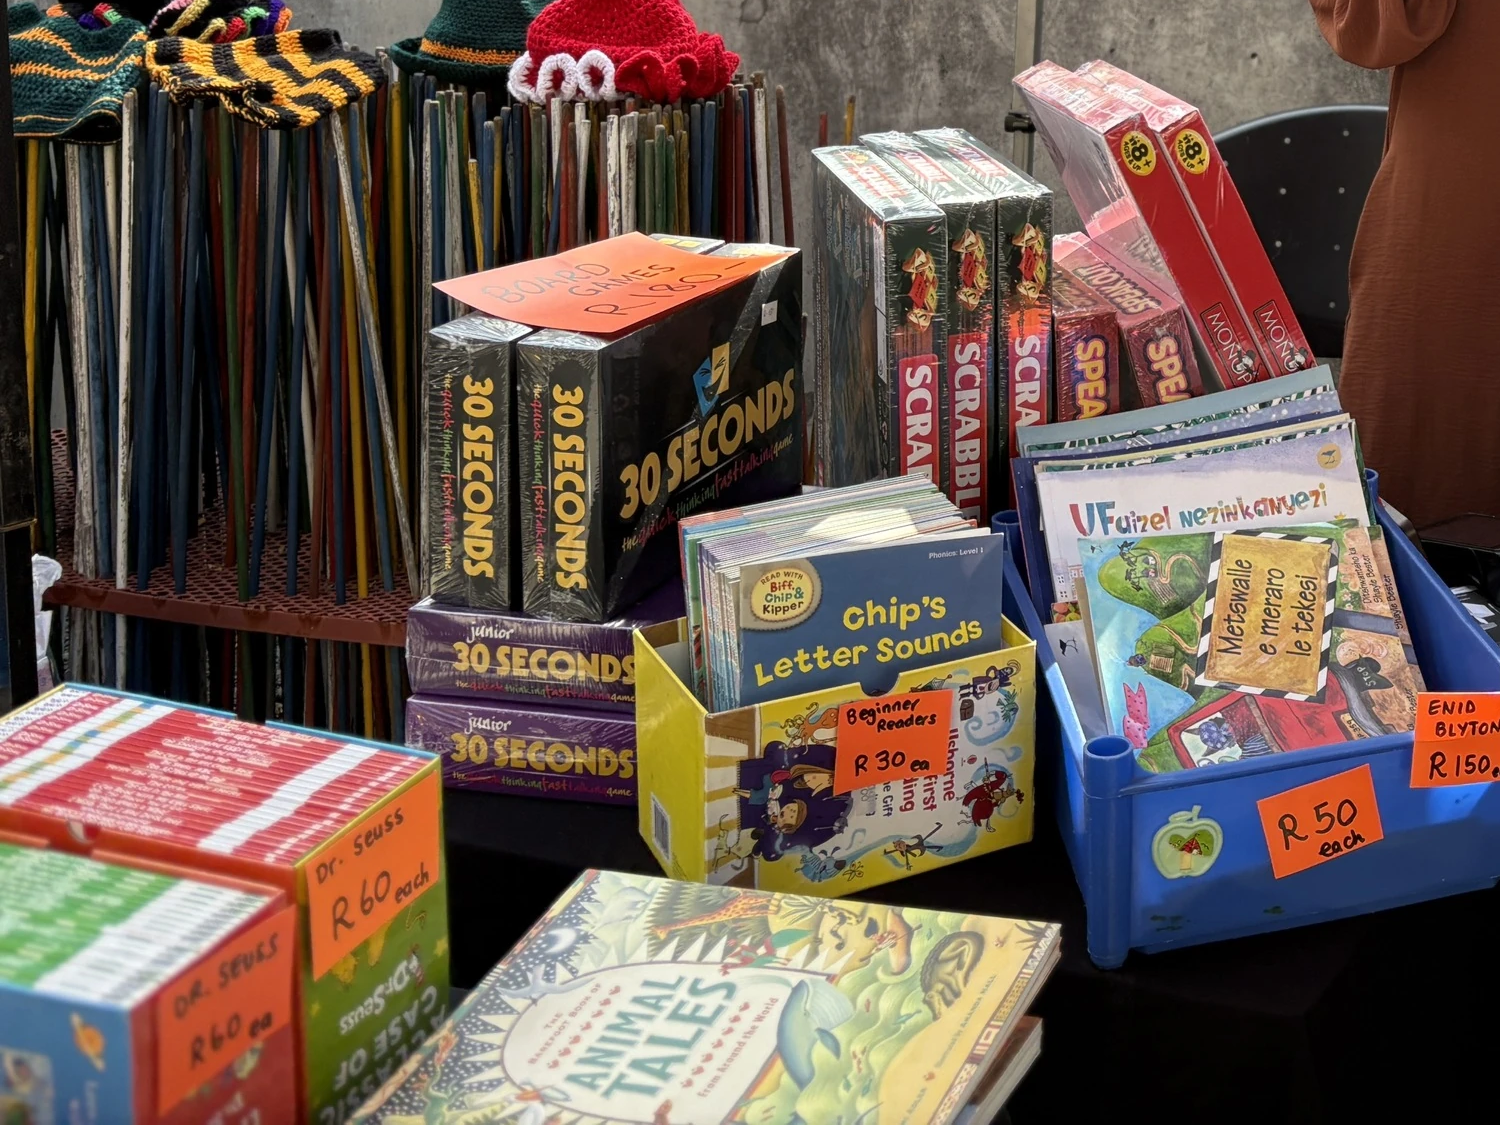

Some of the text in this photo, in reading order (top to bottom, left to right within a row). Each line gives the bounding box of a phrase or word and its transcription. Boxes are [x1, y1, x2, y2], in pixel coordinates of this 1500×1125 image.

[482, 263, 610, 304] BOARD
[568, 263, 675, 297] GAMES
[619, 369, 796, 519] 30 SECONDS
[929, 547, 979, 559] Phonics: Level
[843, 596, 947, 631] Chip's
[1215, 556, 1255, 656] Metswalle
[1259, 568, 1286, 655] e meraro
[1283, 574, 1320, 655] le tekesi
[754, 620, 983, 687] Letter Sounds
[465, 712, 511, 734] junior
[846, 698, 920, 726] Beginner
[877, 713, 937, 733] Readers
[1428, 700, 1475, 716] ENID
[450, 733, 633, 778] 30 SECONDS
[854, 750, 930, 776] R 30 ea
[1429, 751, 1490, 780] R 150
[1278, 799, 1357, 850] R 50
[1319, 829, 1365, 857] each
[394, 862, 429, 904] each
[563, 975, 687, 1092] ANIMAL
[601, 977, 738, 1100] TALES
